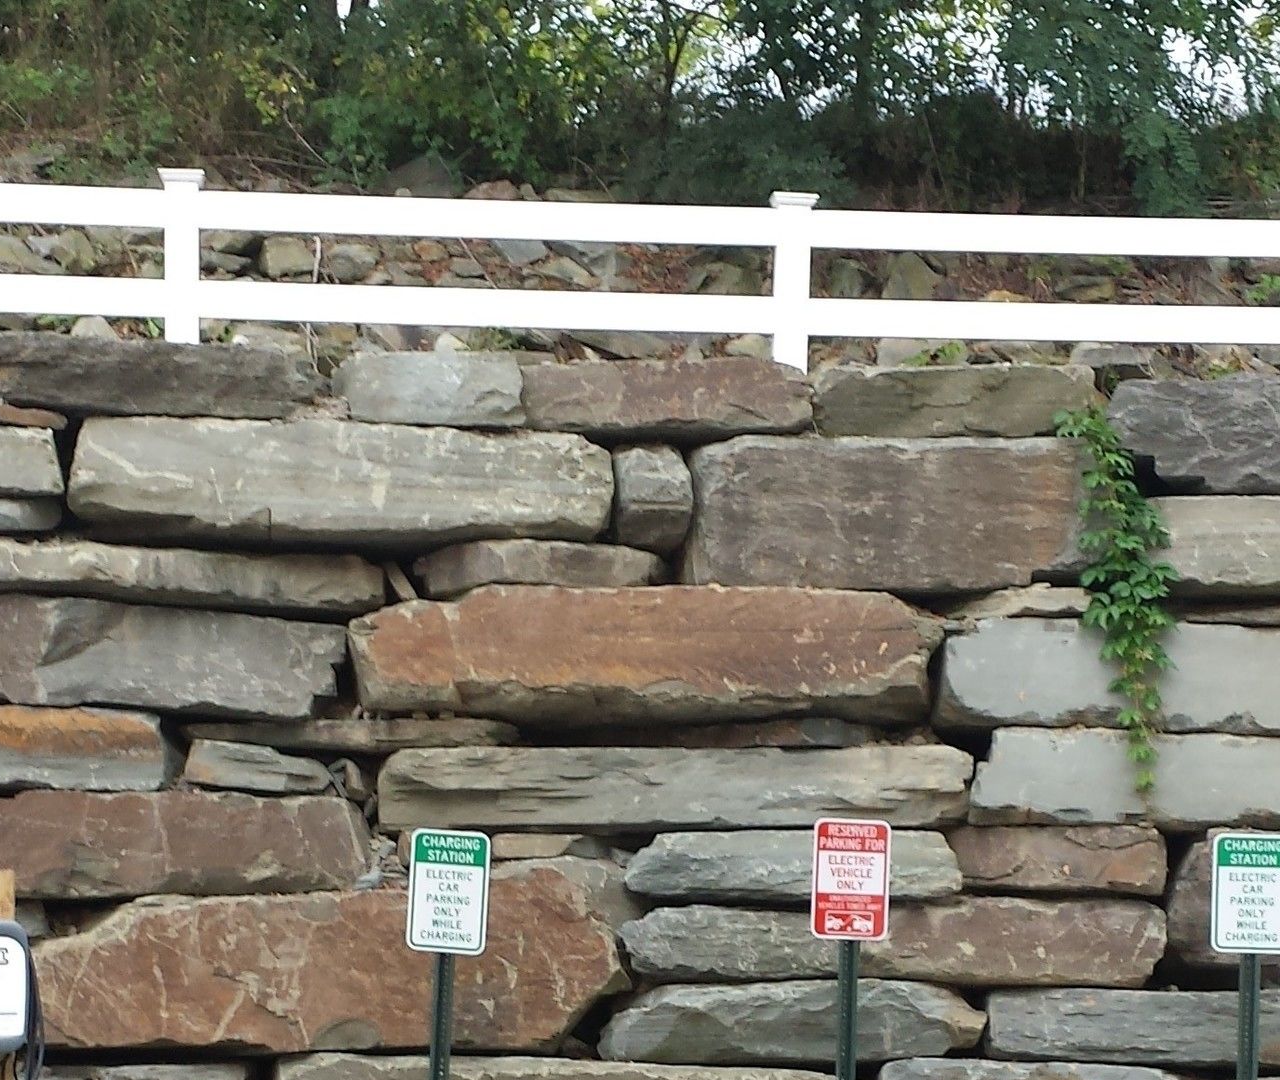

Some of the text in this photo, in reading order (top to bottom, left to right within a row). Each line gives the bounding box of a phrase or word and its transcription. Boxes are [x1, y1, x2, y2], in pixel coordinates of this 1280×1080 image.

[828, 824, 878, 837] RESERVED
[422, 835, 480, 851] CHARGING
[820, 837, 885, 851] PARKING FOR
[427, 849, 475, 864] STATION
[828, 855, 875, 866] ELECTRIC
[1230, 853, 1278, 865] STATION
[426, 869, 473, 881] ELECTRIC
[830, 867, 872, 878] VEHICLE
[1229, 872, 1277, 883] ELECTRIC
[438, 883, 459, 892] CAR
[836, 880, 864, 890] ONLY
[1242, 885, 1263, 893] CAR
[426, 894, 470, 905] PARKING
[1230, 897, 1274, 906] PARKING
[433, 907, 461, 917] ONLY
[1237, 909, 1265, 918] ONLY
[432, 919, 462, 930] WHILE
[1236, 921, 1267, 930] WHILE
[420, 930, 472, 943] CHARGING
[1225, 932, 1278, 942] CHARGING
